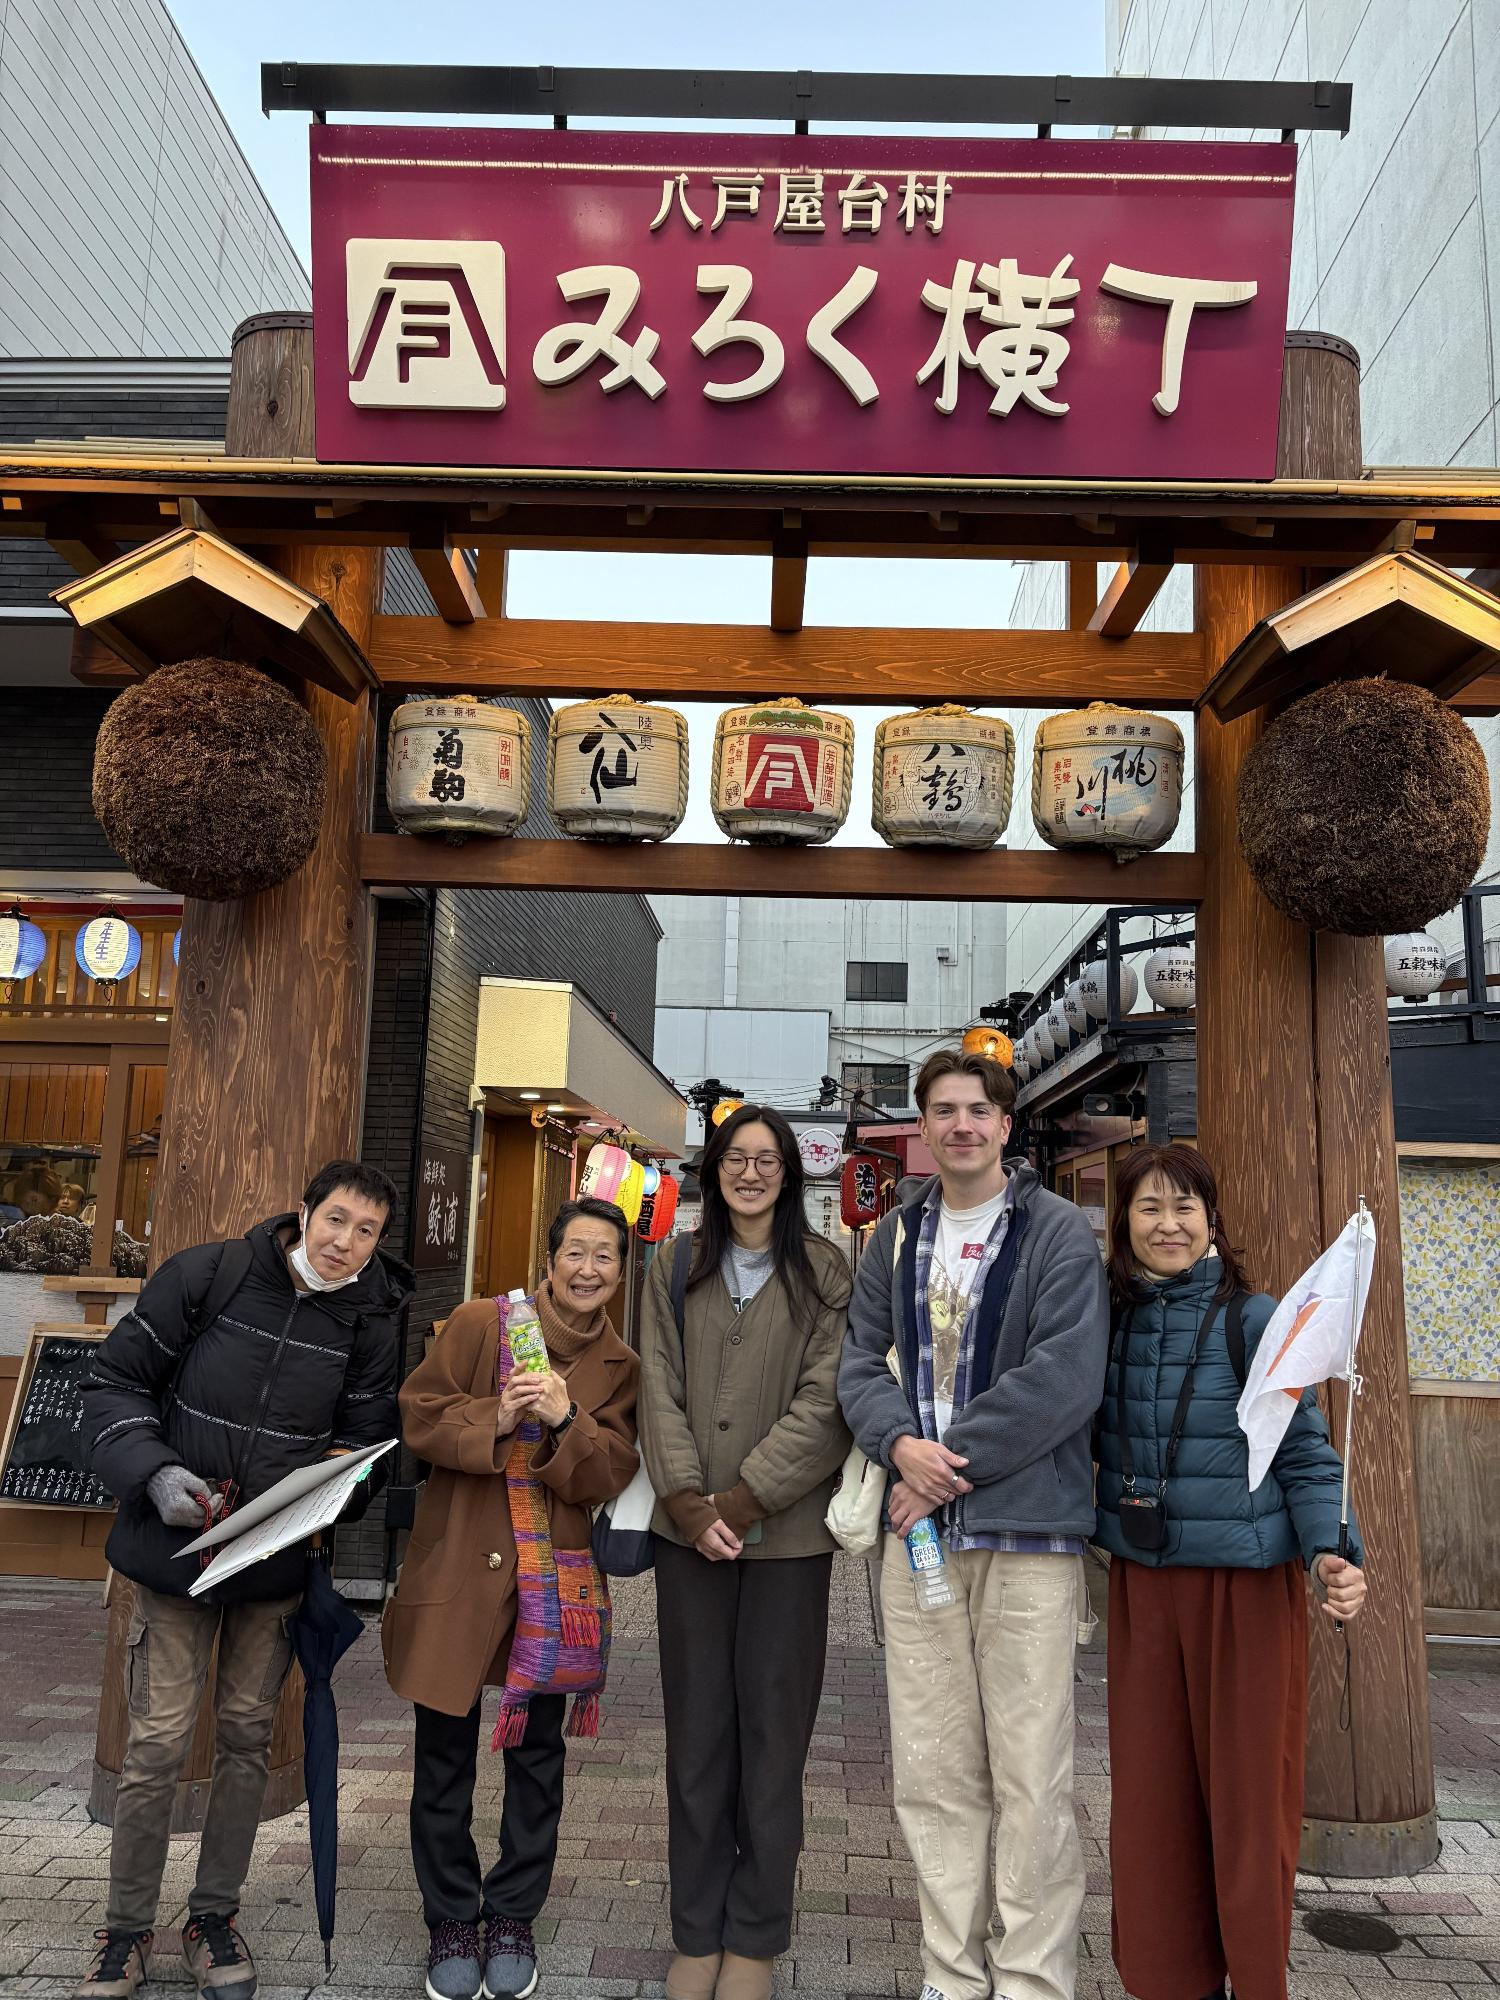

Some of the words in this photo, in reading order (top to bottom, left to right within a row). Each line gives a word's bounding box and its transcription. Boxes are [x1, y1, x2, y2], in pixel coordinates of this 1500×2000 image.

[649, 172, 953, 235] 八戸屋台村
[532, 252, 1258, 418] みろく横丁
[578, 711, 639, 805] 八仙
[914, 1545, 937, 1558] GREEN
